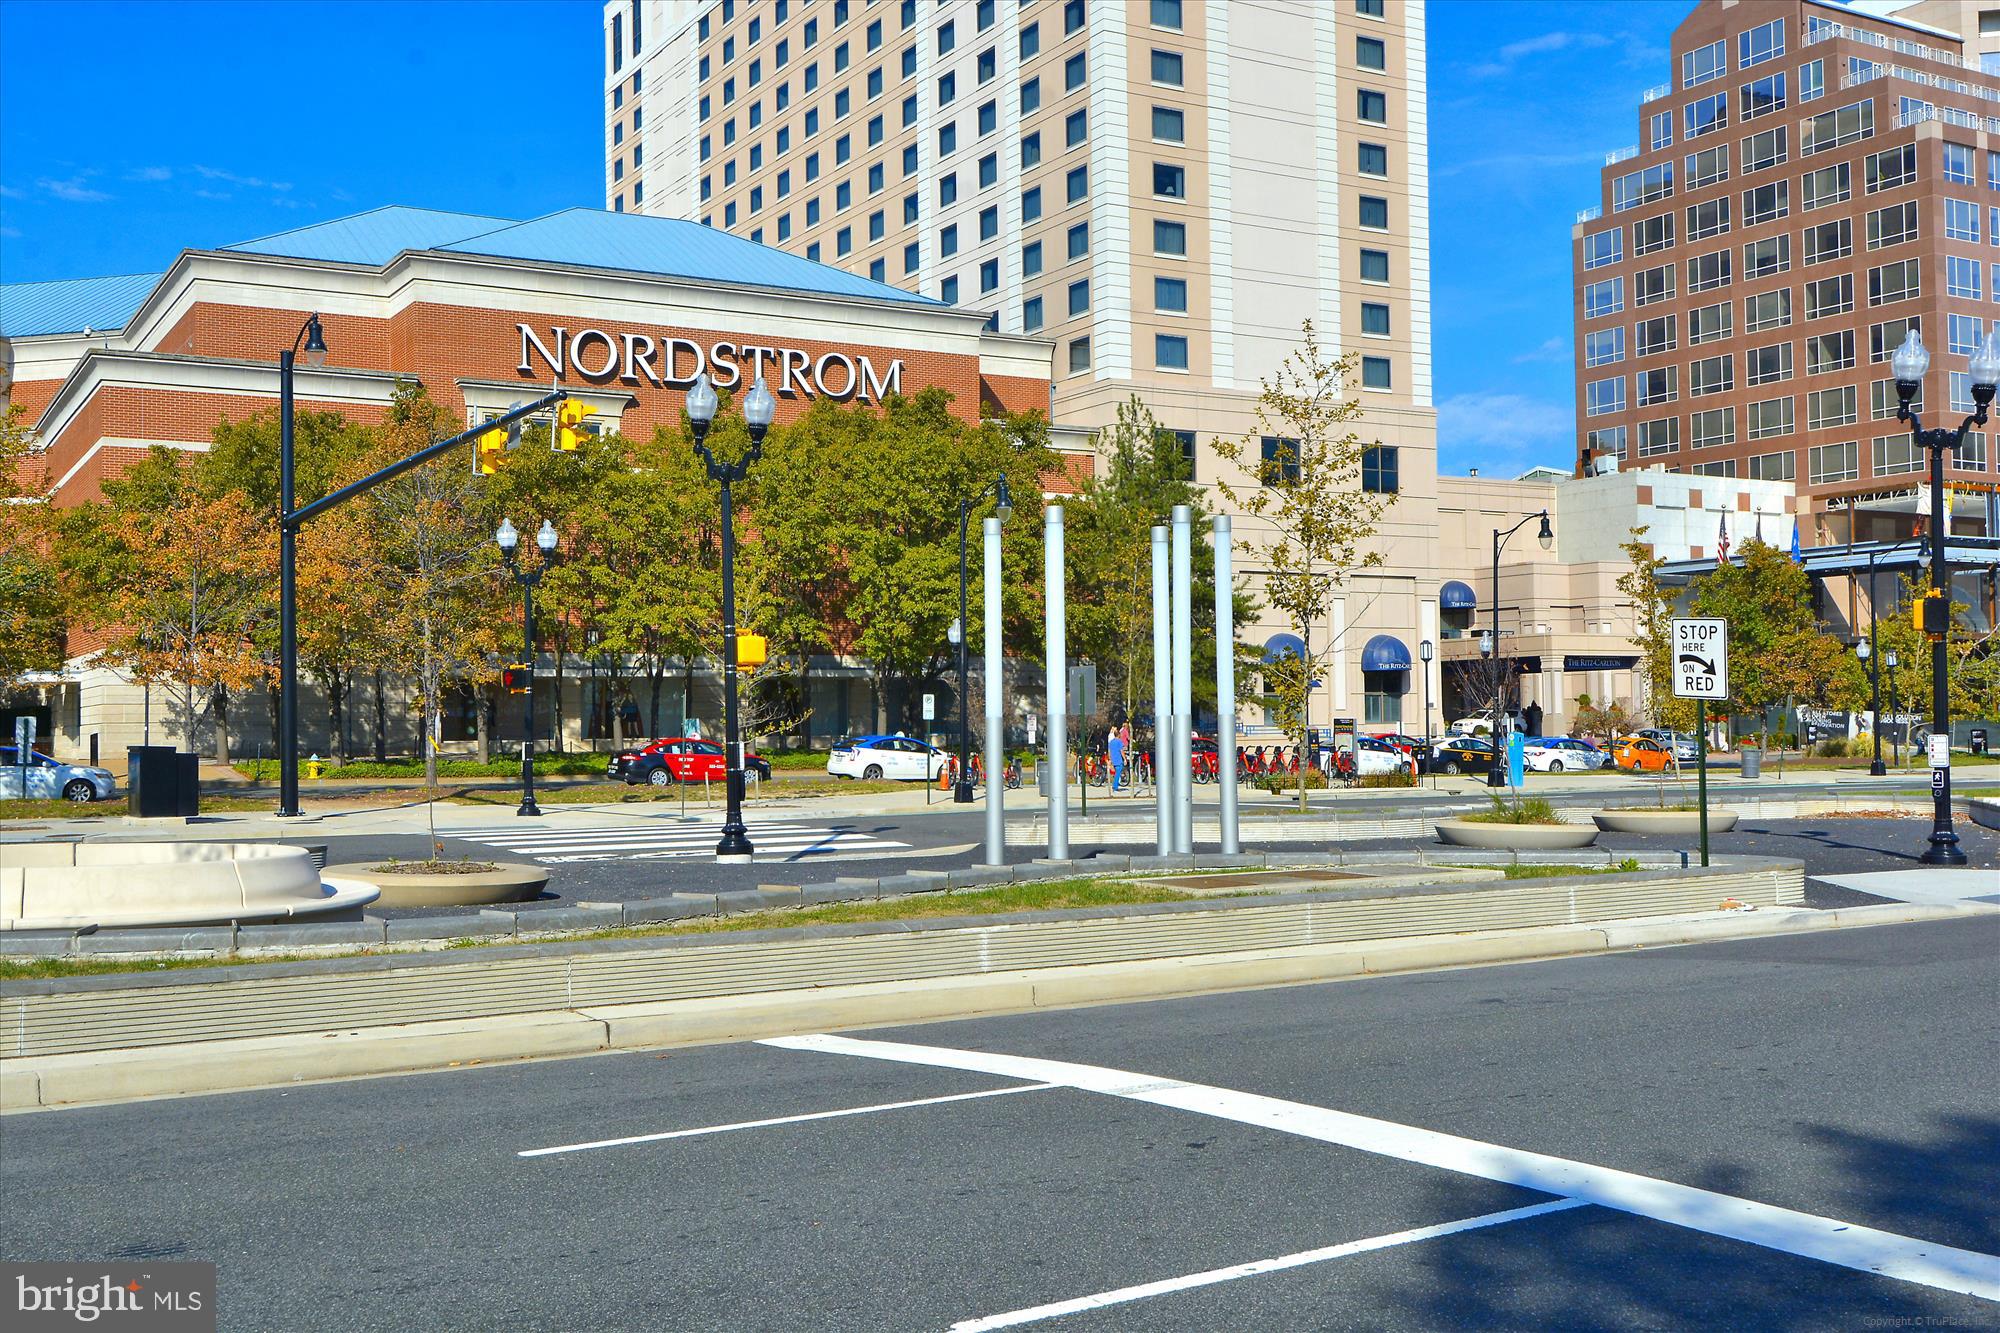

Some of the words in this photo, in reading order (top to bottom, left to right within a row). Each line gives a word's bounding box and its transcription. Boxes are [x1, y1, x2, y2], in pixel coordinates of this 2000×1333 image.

[516, 323, 904, 399] NORDSTROM
[1680, 625, 1718, 640] STOP
[1682, 643, 1705, 652] HERE
[1568, 659, 1580, 667] THE
[1580, 658, 1621, 667] RITZ-CARLTON
[1683, 664, 1695, 673] ON
[1685, 676, 1714, 691] RED
